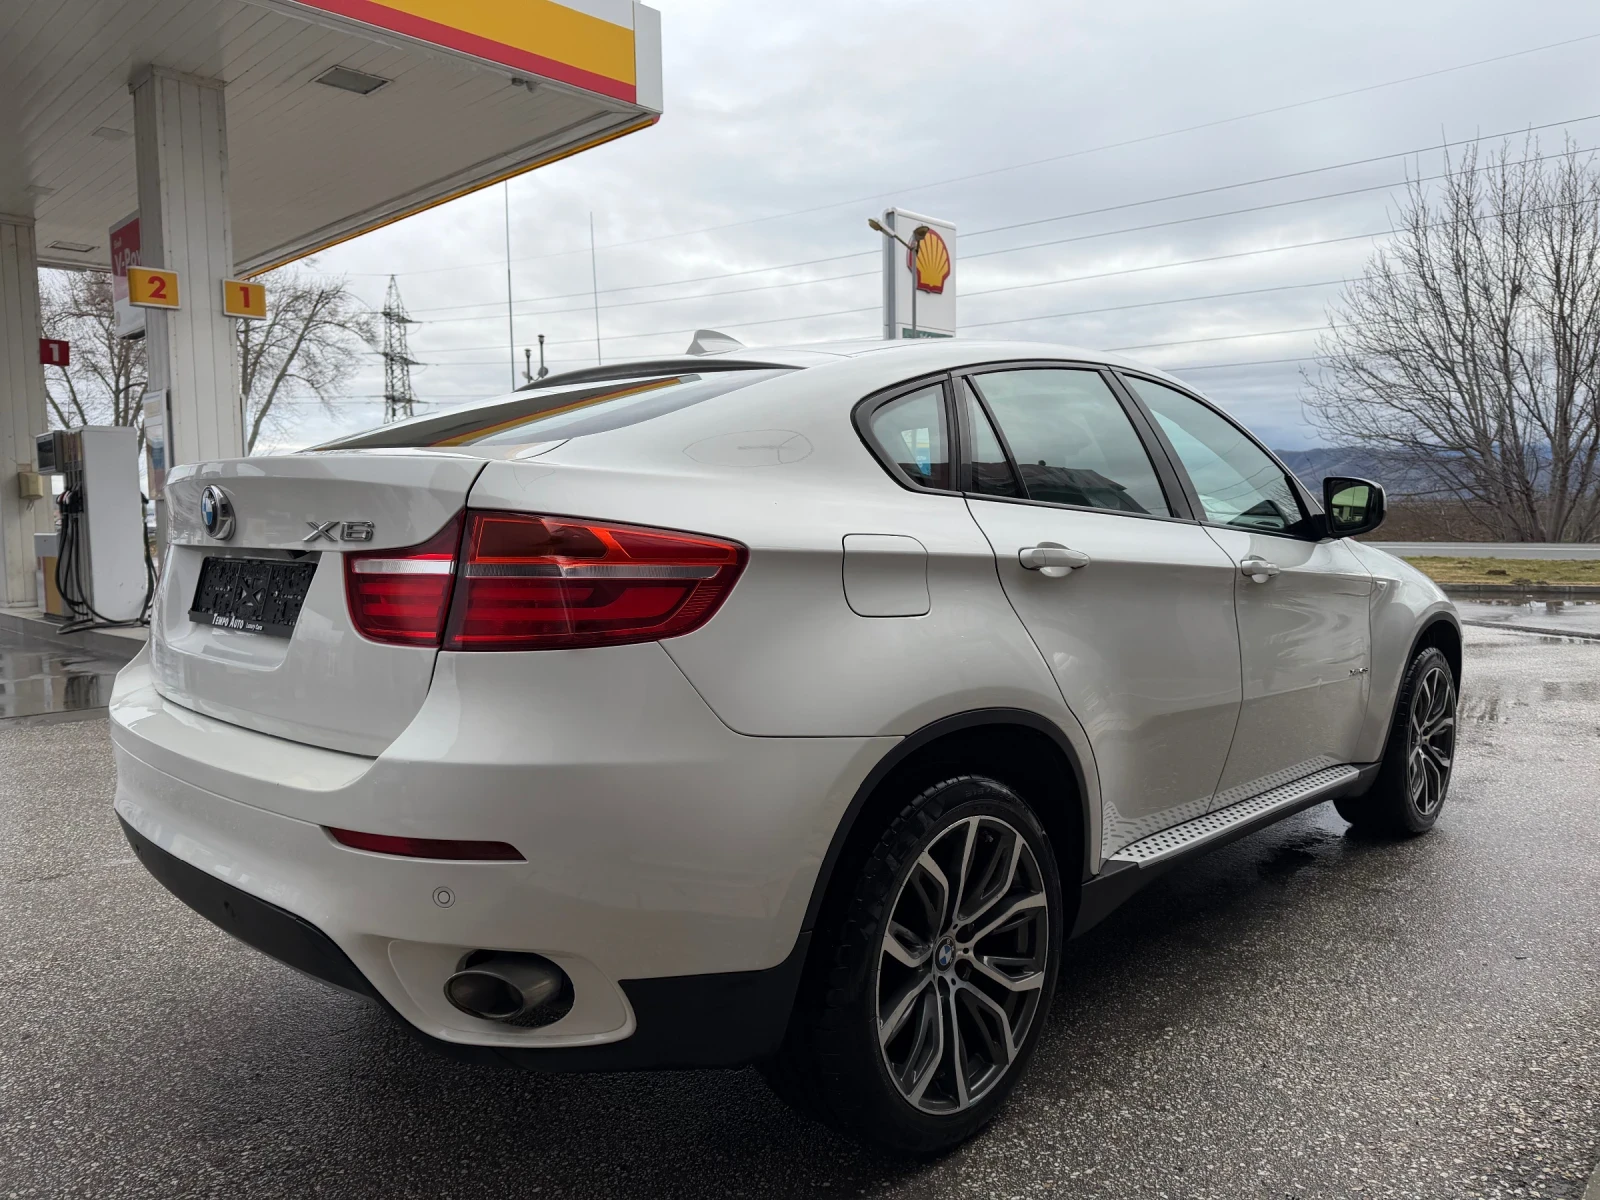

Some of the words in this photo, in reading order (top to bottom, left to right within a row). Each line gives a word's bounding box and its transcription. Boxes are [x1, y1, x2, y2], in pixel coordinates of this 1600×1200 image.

[147, 275, 167, 300] 2
[239, 286, 250, 308] 1
[48, 343, 59, 362] 1
[302, 520, 375, 542] X6
